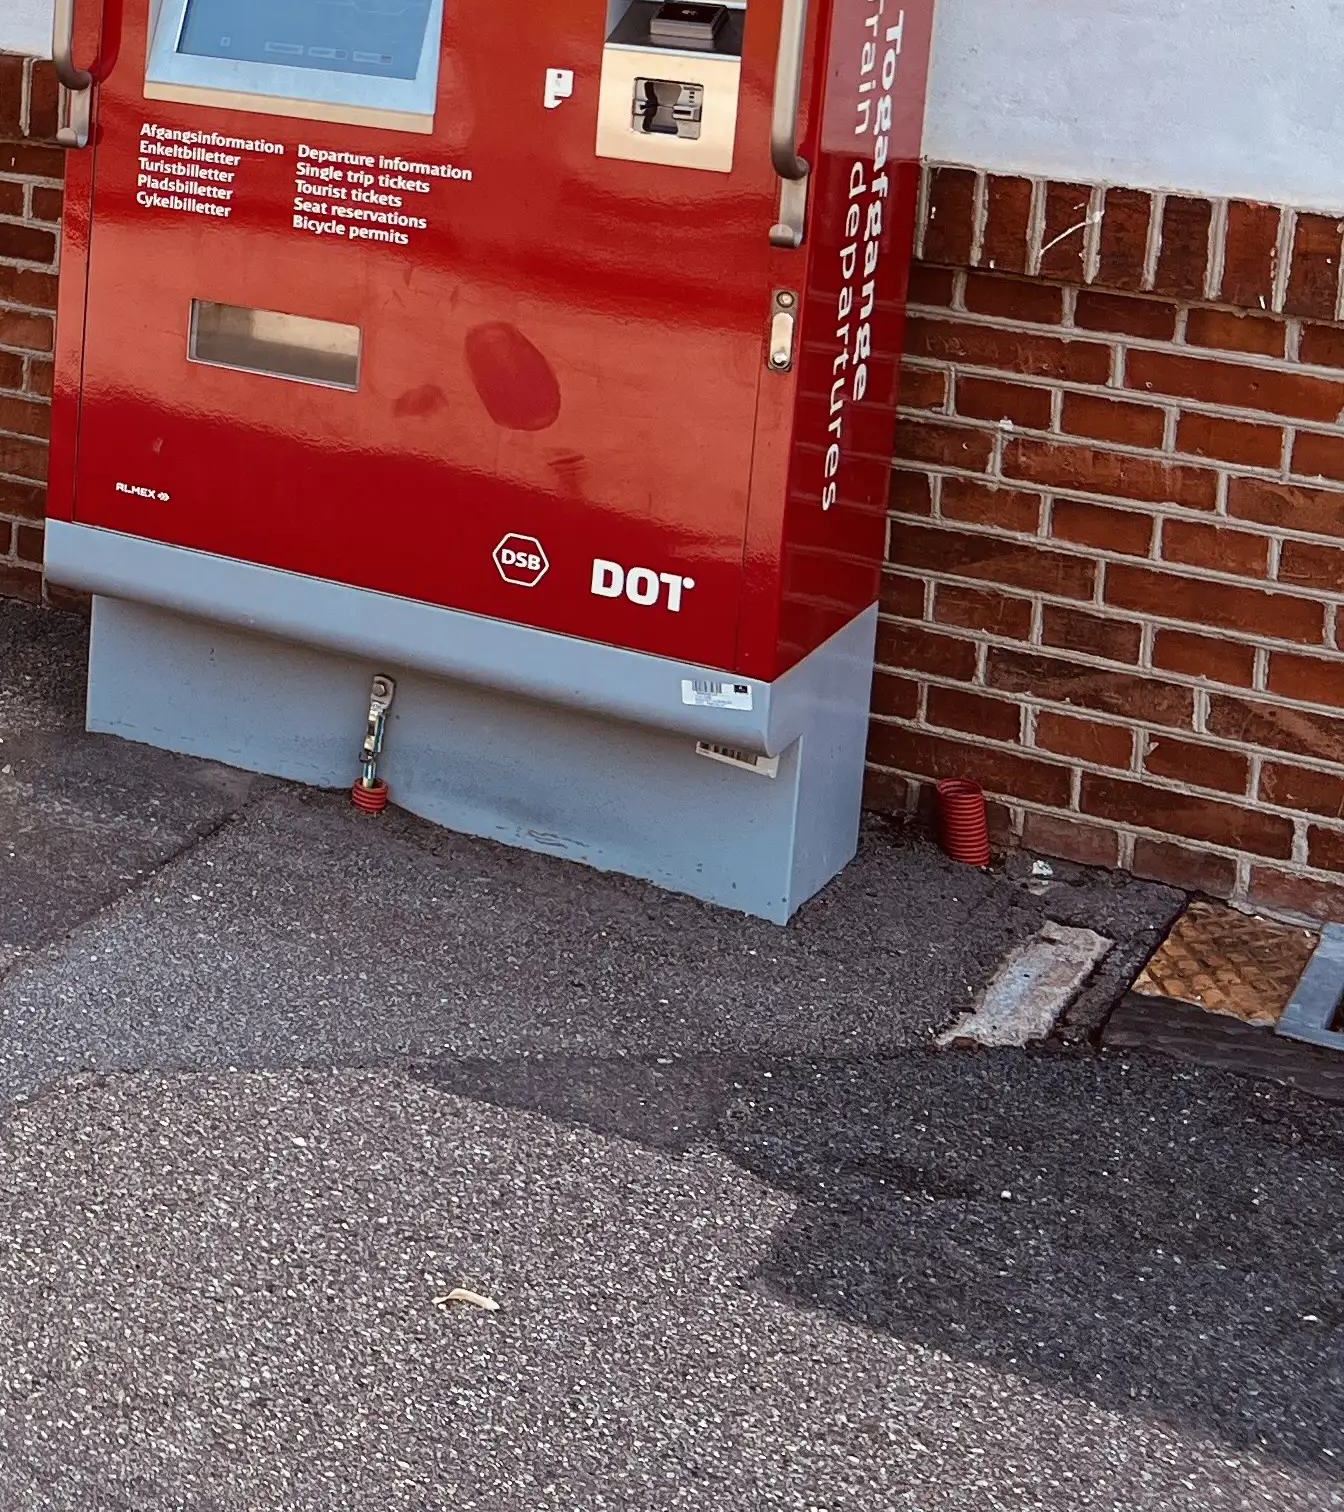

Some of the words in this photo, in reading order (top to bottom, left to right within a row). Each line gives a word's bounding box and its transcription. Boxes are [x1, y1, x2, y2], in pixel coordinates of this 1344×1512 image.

[139, 122, 285, 155] Afgangsinformation
[139, 140, 242, 166] Enkeltbilletter
[137, 157, 236, 183] Turistbilletter
[295, 161, 344, 182] Single
[346, 170, 375, 187] trip
[377, 174, 431, 193] tickets
[297, 143, 376, 168] Departure
[378, 155, 473, 181] information
[137, 174, 234, 201] Pladsbilletter
[294, 179, 348, 200] Tourist
[350, 188, 403, 208] tickets
[136, 190, 232, 218] Cykelbilletter
[293, 197, 329, 215] Seat
[330, 204, 428, 230] reservations
[852, 9, 905, 402] Togafgange
[292, 214, 346, 235] Bicycle
[348, 225, 410, 245] permits
[821, 160, 868, 512] departures
[500, 548, 541, 571] DSB
[590, 558, 688, 613] DOT
